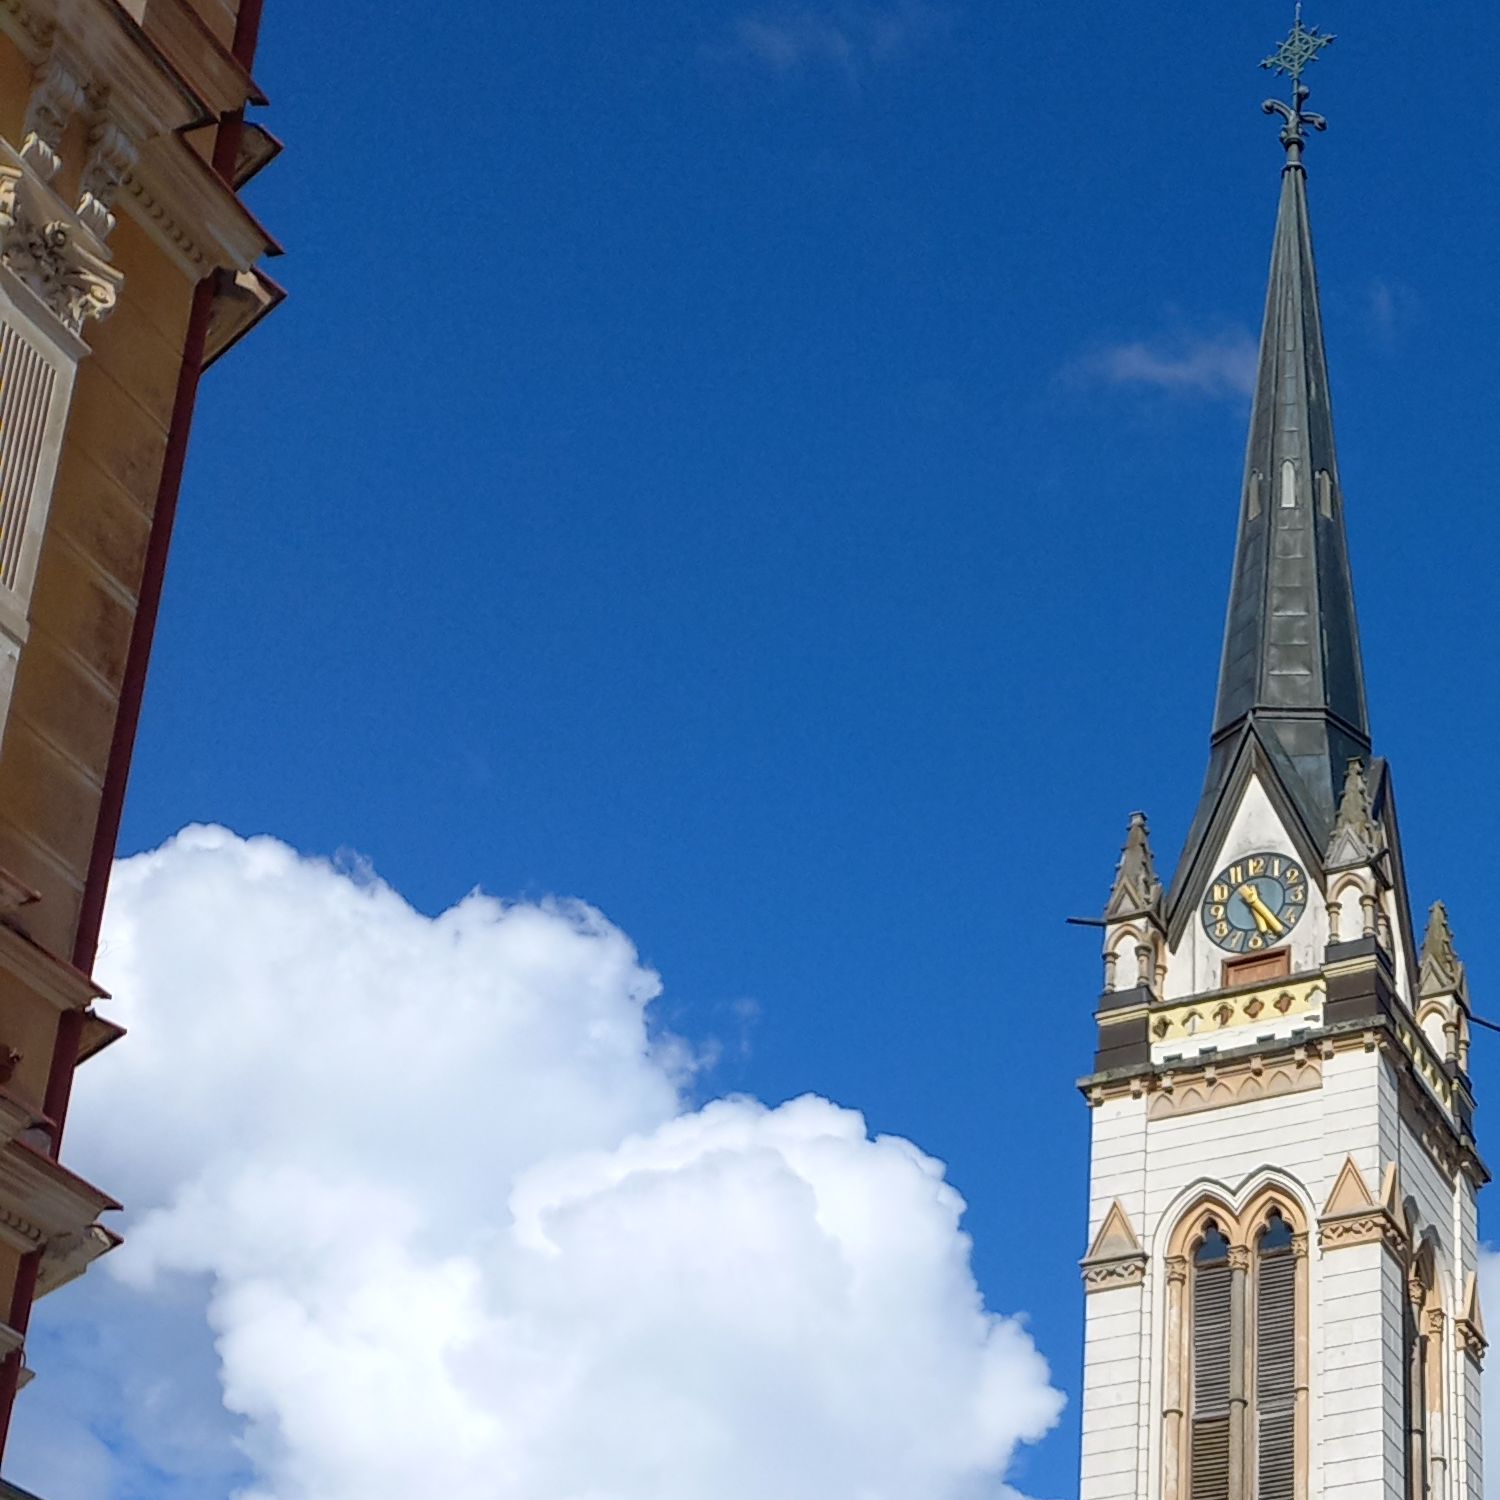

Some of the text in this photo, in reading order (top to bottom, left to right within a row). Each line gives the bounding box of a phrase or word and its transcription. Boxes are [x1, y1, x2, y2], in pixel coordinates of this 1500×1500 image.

[1229, 863, 1243, 885] 11
[1248, 857, 1264, 877] 12
[1273, 858, 1280, 877] 1
[1286, 868, 1299, 884] 2
[1213, 884, 1229, 903] 10
[1291, 884, 1304, 902] 3
[1210, 905, 1224, 920] 9
[1285, 907, 1296, 924] 4
[1215, 920, 1229, 938] 8
[1231, 931, 1243, 949] 7
[1248, 931, 1263, 949] 6
